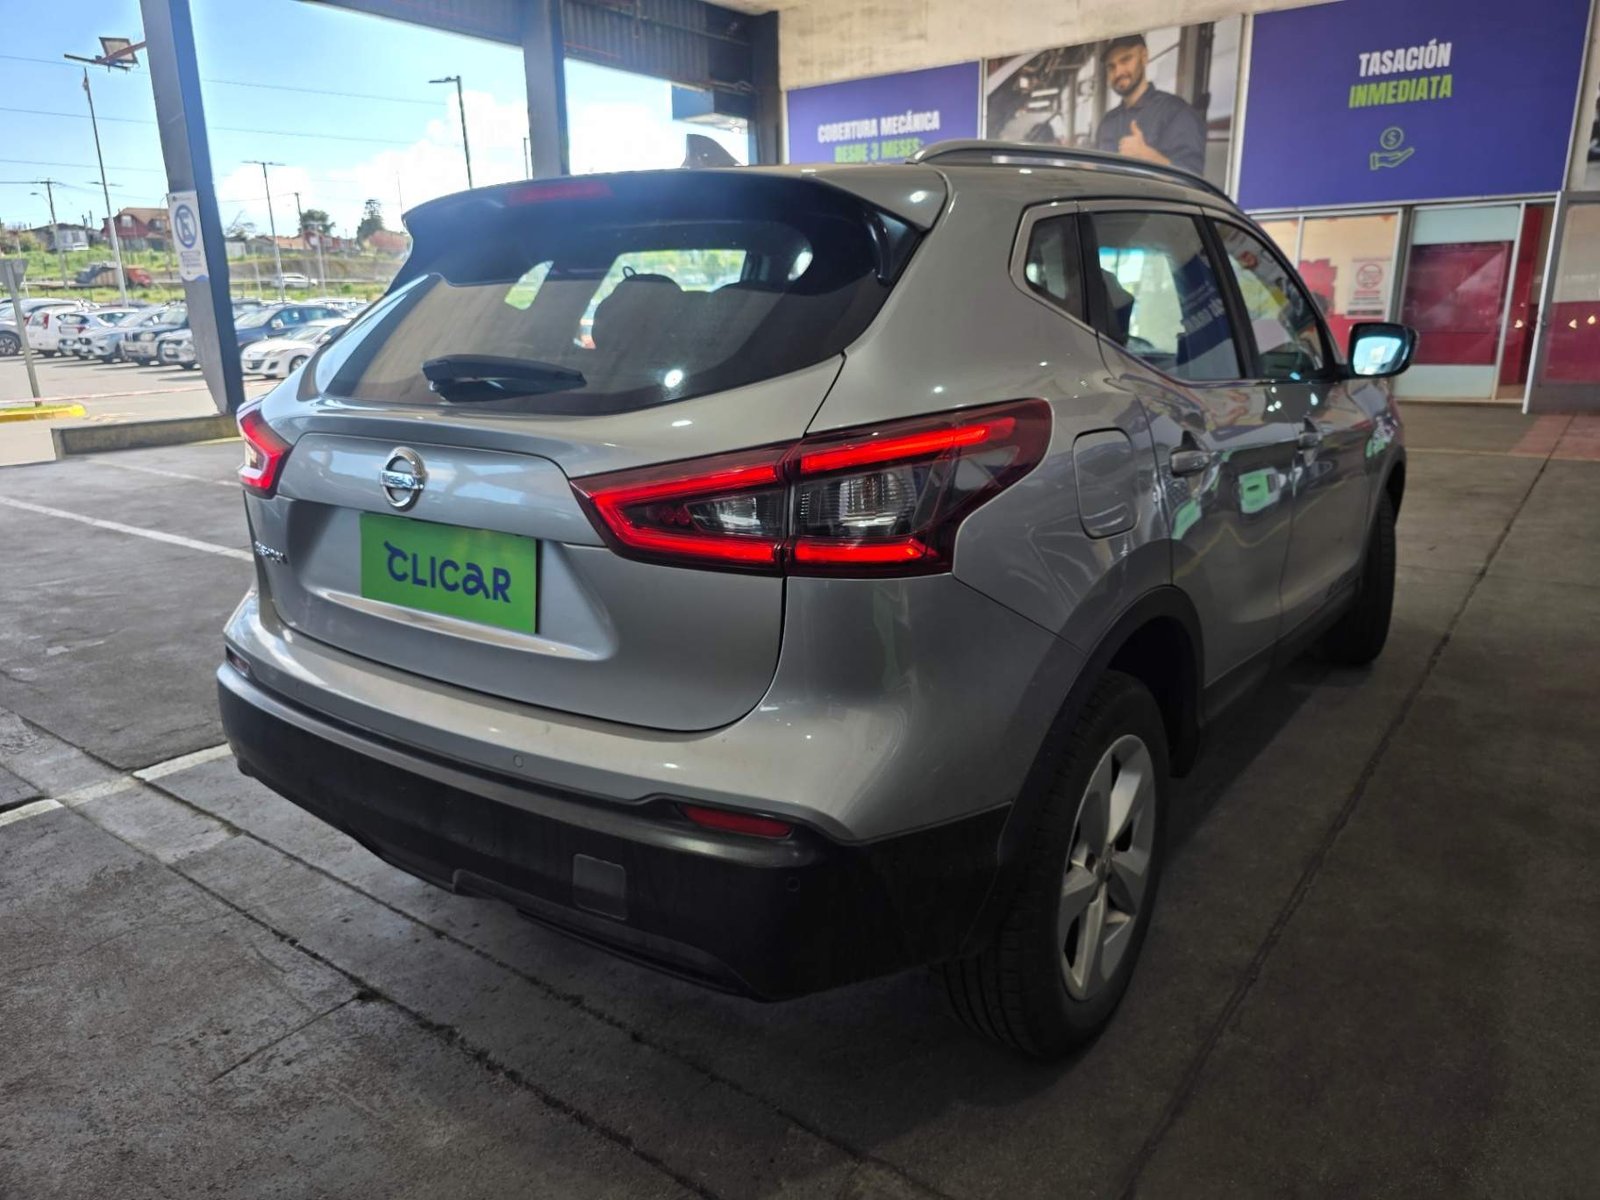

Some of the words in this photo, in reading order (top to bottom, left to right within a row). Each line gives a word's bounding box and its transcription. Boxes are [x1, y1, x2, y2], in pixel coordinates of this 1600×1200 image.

[1359, 38, 1452, 78] TASACIÓN
[1348, 74, 1452, 108] INMEDIATA
[817, 117, 879, 144] COBERTURA
[880, 109, 940, 136] MECÁNICA
[834, 142, 868, 163] DESDE
[870, 141, 879, 161] 3
[381, 471, 416, 488] NISSAN
